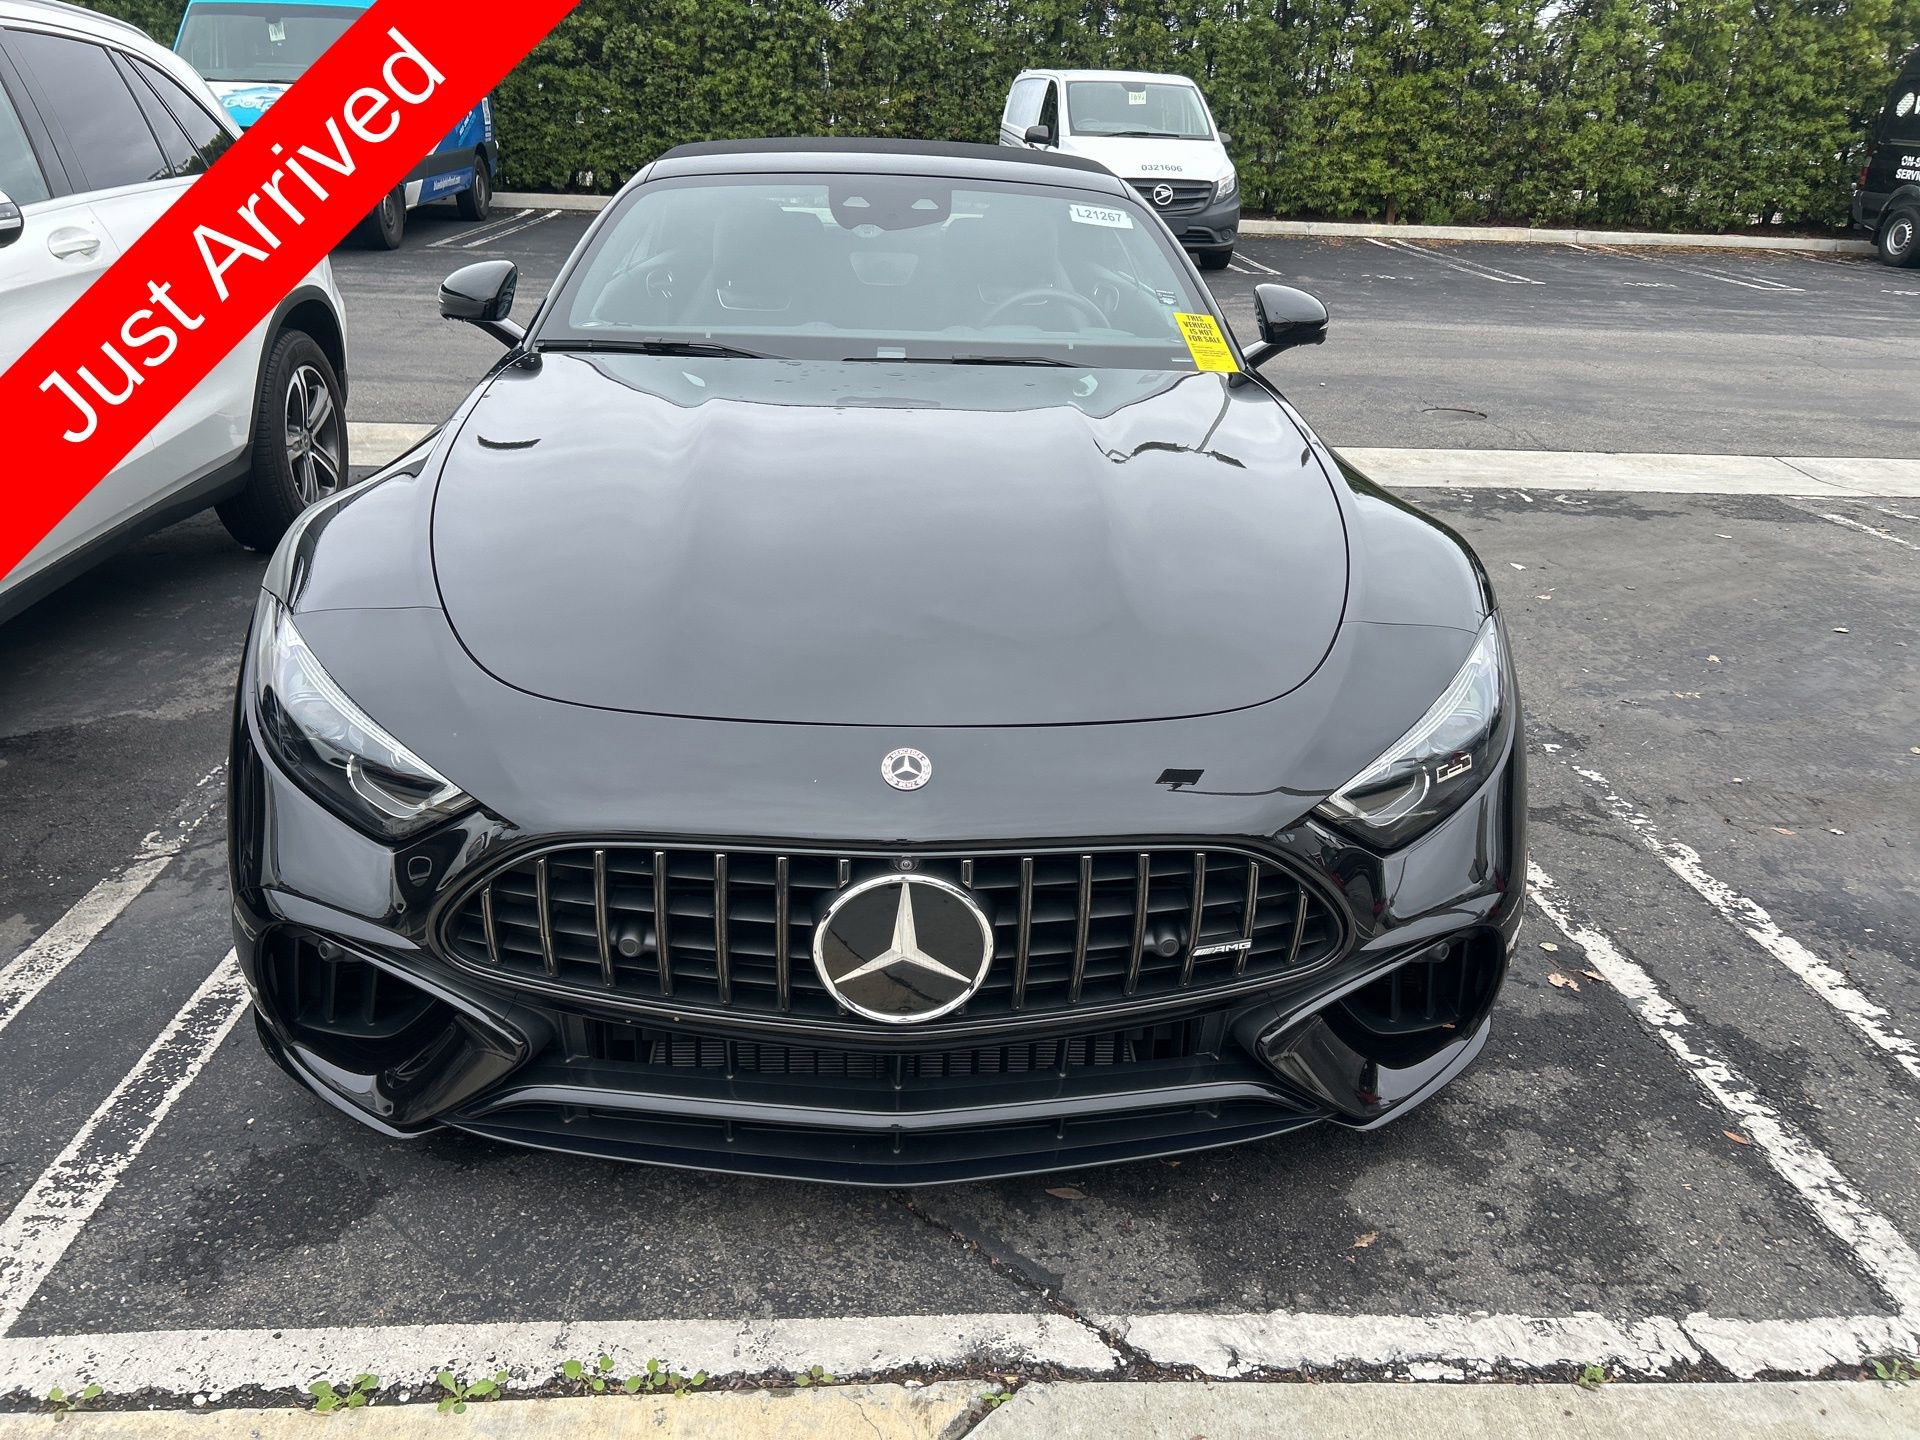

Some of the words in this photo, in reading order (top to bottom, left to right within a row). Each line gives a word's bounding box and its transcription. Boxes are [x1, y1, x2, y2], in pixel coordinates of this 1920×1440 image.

[1141, 164, 1183, 173] 0321606
[1895, 168, 1920, 181] SERVI
[1076, 207, 1122, 222] L21267
[1182, 321, 1214, 330] VEHICLE
[1187, 334, 1203, 342] FOR
[1203, 336, 1222, 344] SALE
